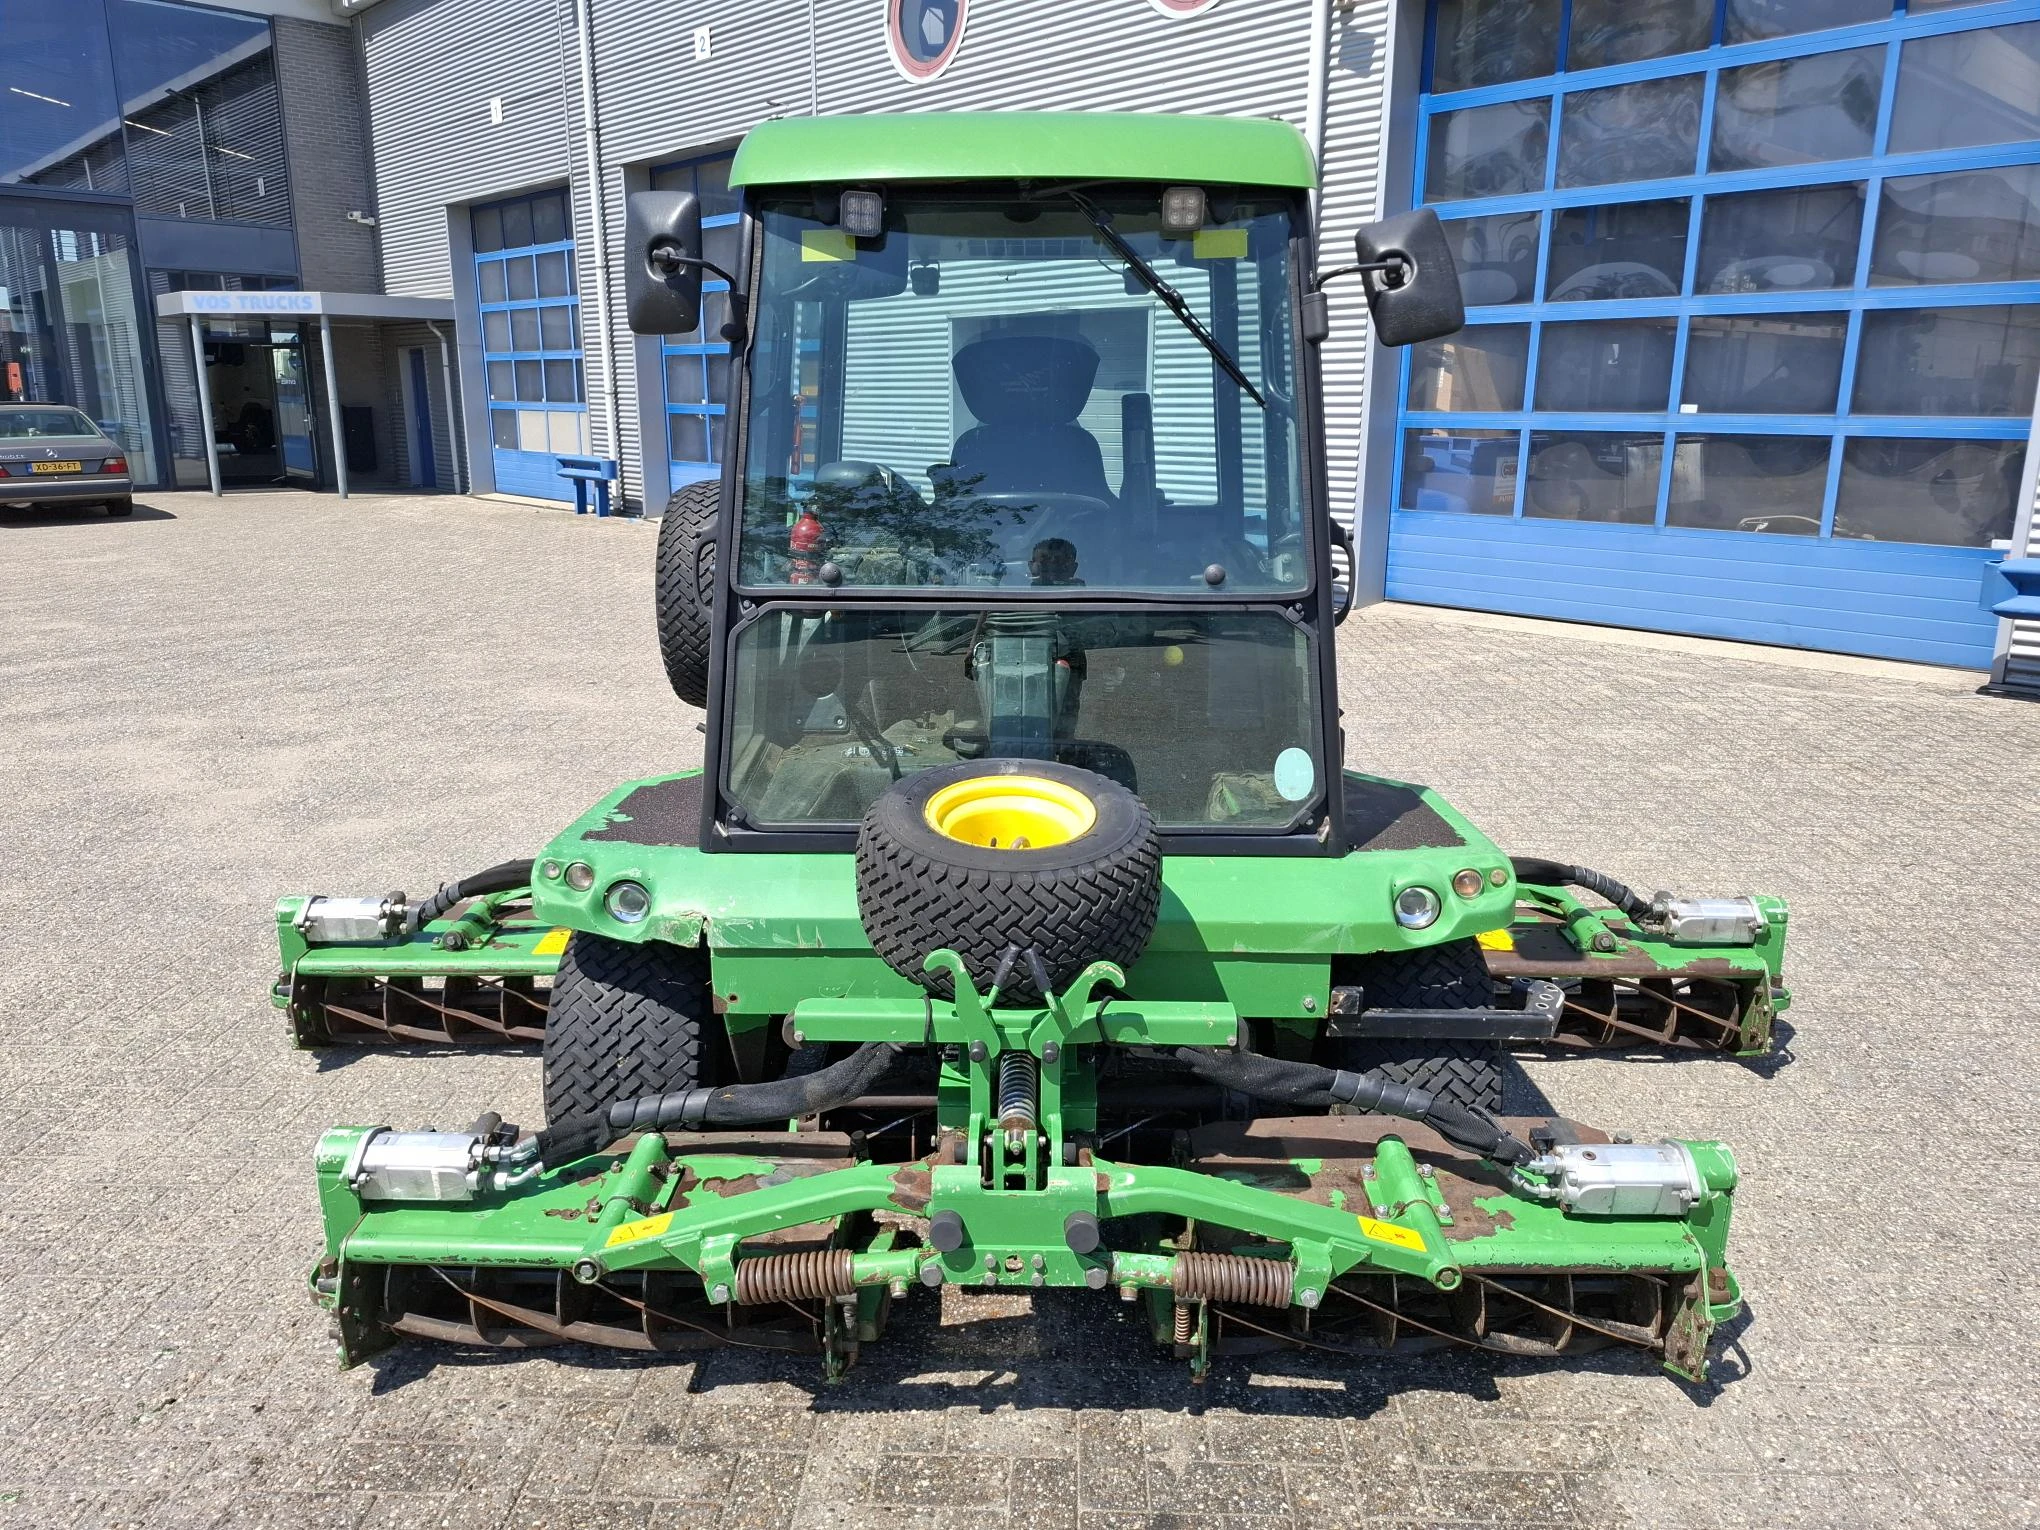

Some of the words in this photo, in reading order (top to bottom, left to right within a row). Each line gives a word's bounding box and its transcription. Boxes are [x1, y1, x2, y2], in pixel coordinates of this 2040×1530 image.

[699, 35, 706, 53] 2
[193, 295, 231, 310] VOS
[236, 295, 313, 310] TRUCKS
[36, 462, 78, 472] XD-36-FT
